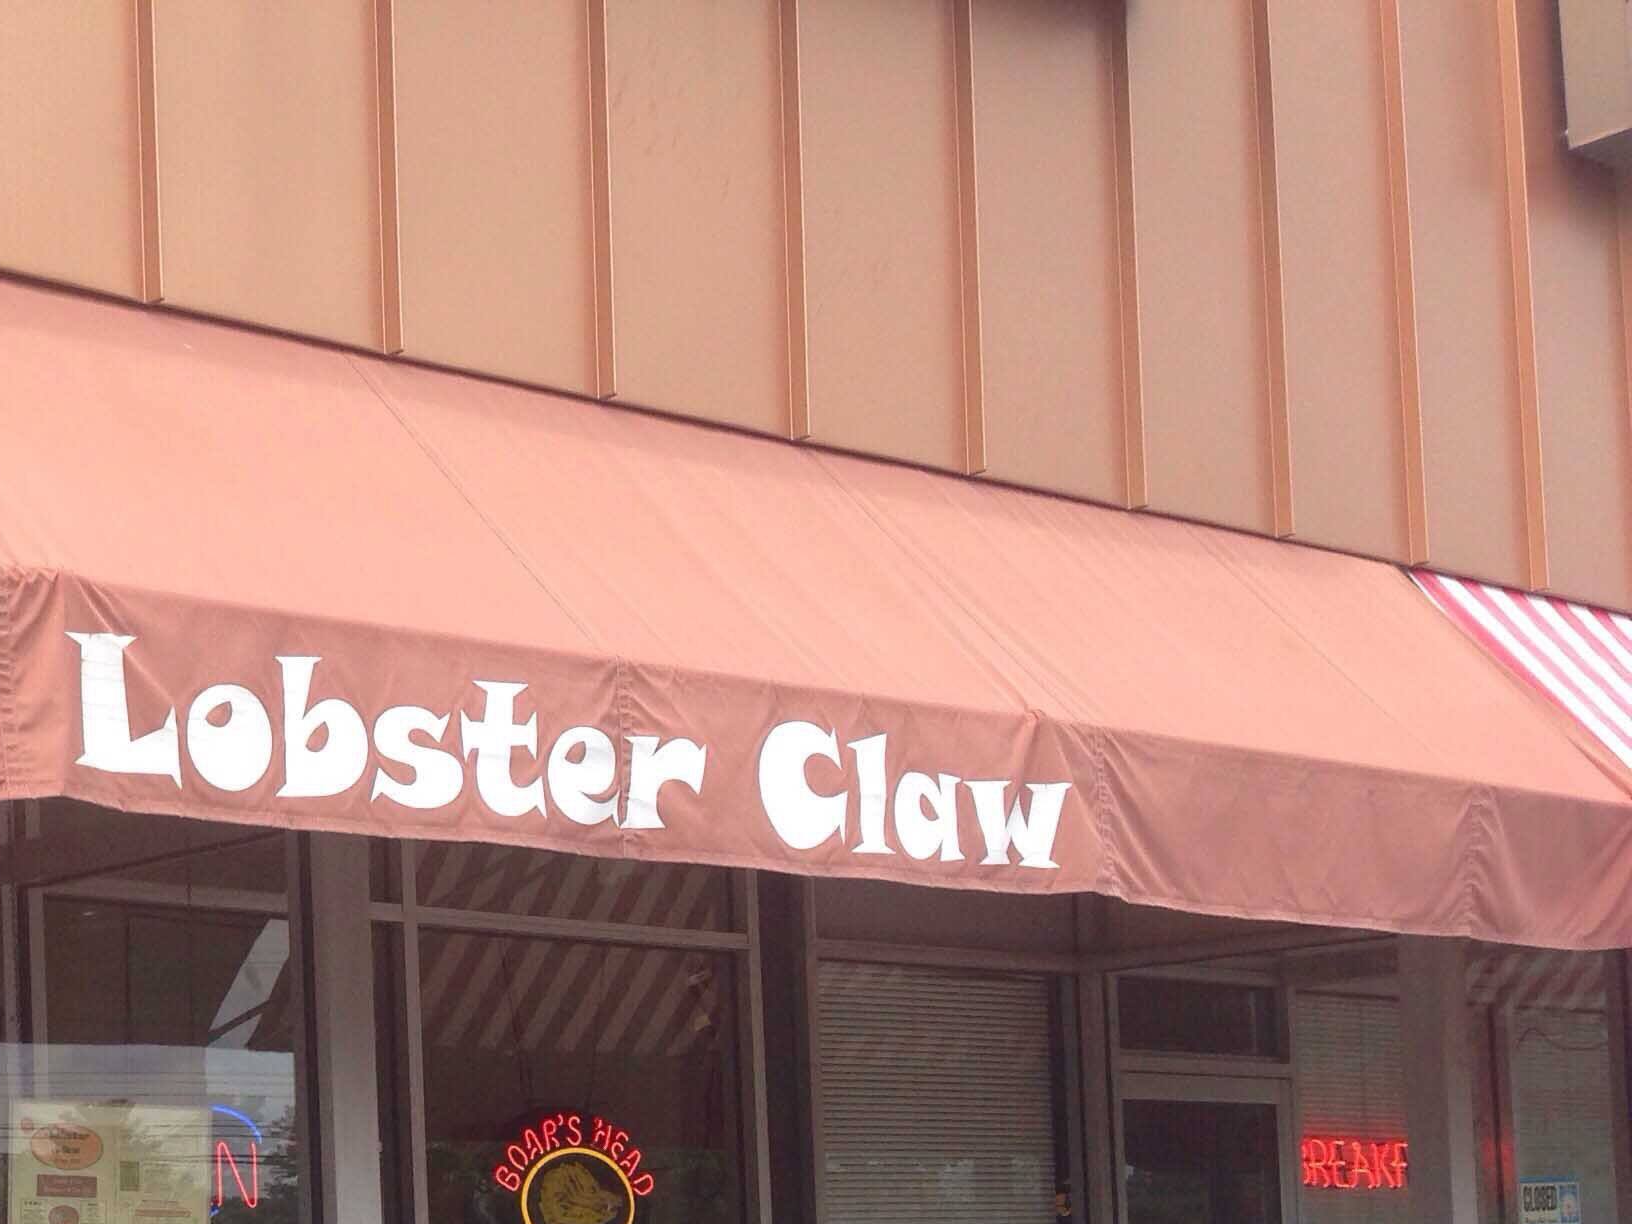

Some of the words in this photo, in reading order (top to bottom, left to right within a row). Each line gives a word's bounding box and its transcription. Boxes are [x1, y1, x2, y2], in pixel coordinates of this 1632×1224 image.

[65, 630, 707, 831] Lobster
[756, 720, 1073, 870] Claw
[495, 1114, 582, 1192] BOAR'S
[594, 1118, 655, 1196] HEAD
[1523, 1186, 1558, 1212] CLOSED
